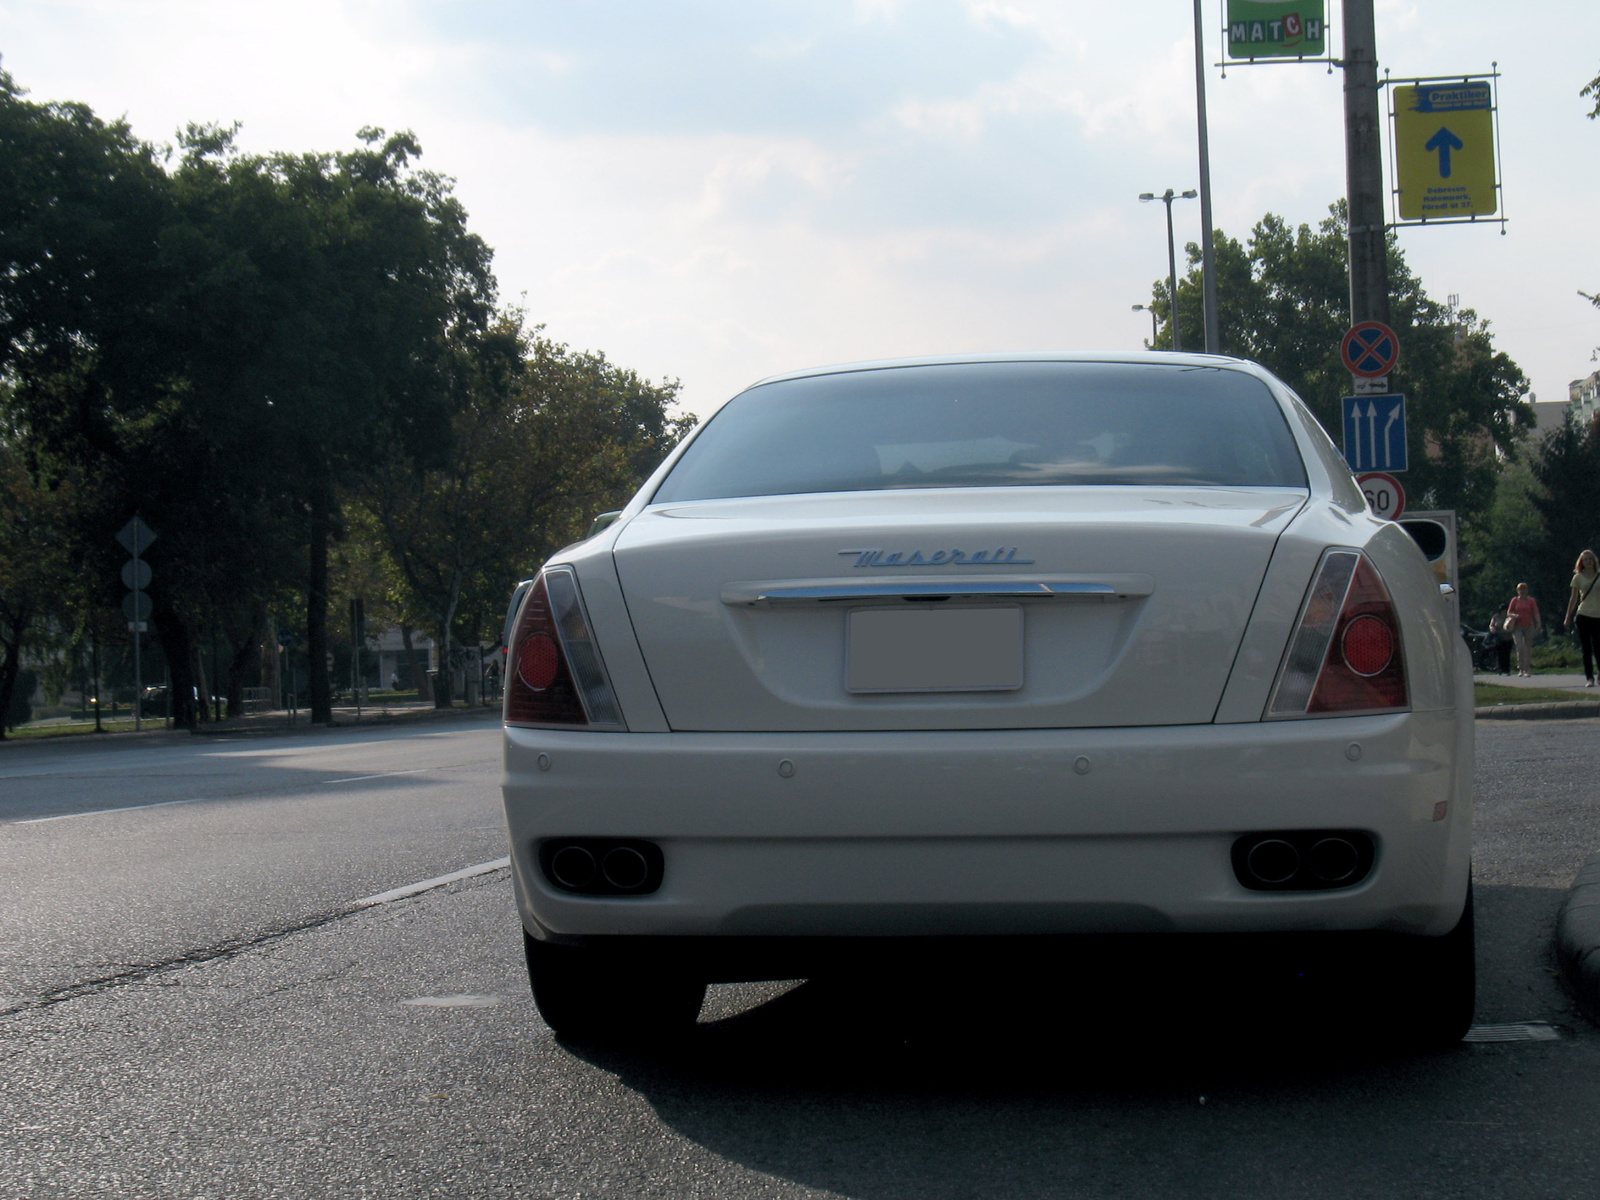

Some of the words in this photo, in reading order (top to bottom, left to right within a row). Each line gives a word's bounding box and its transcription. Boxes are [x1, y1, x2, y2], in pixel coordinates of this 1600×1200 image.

[1230, 15, 1321, 42] MATCH
[1431, 90, 1487, 101] Praktiker
[838, 546, 1035, 567] Maserati
